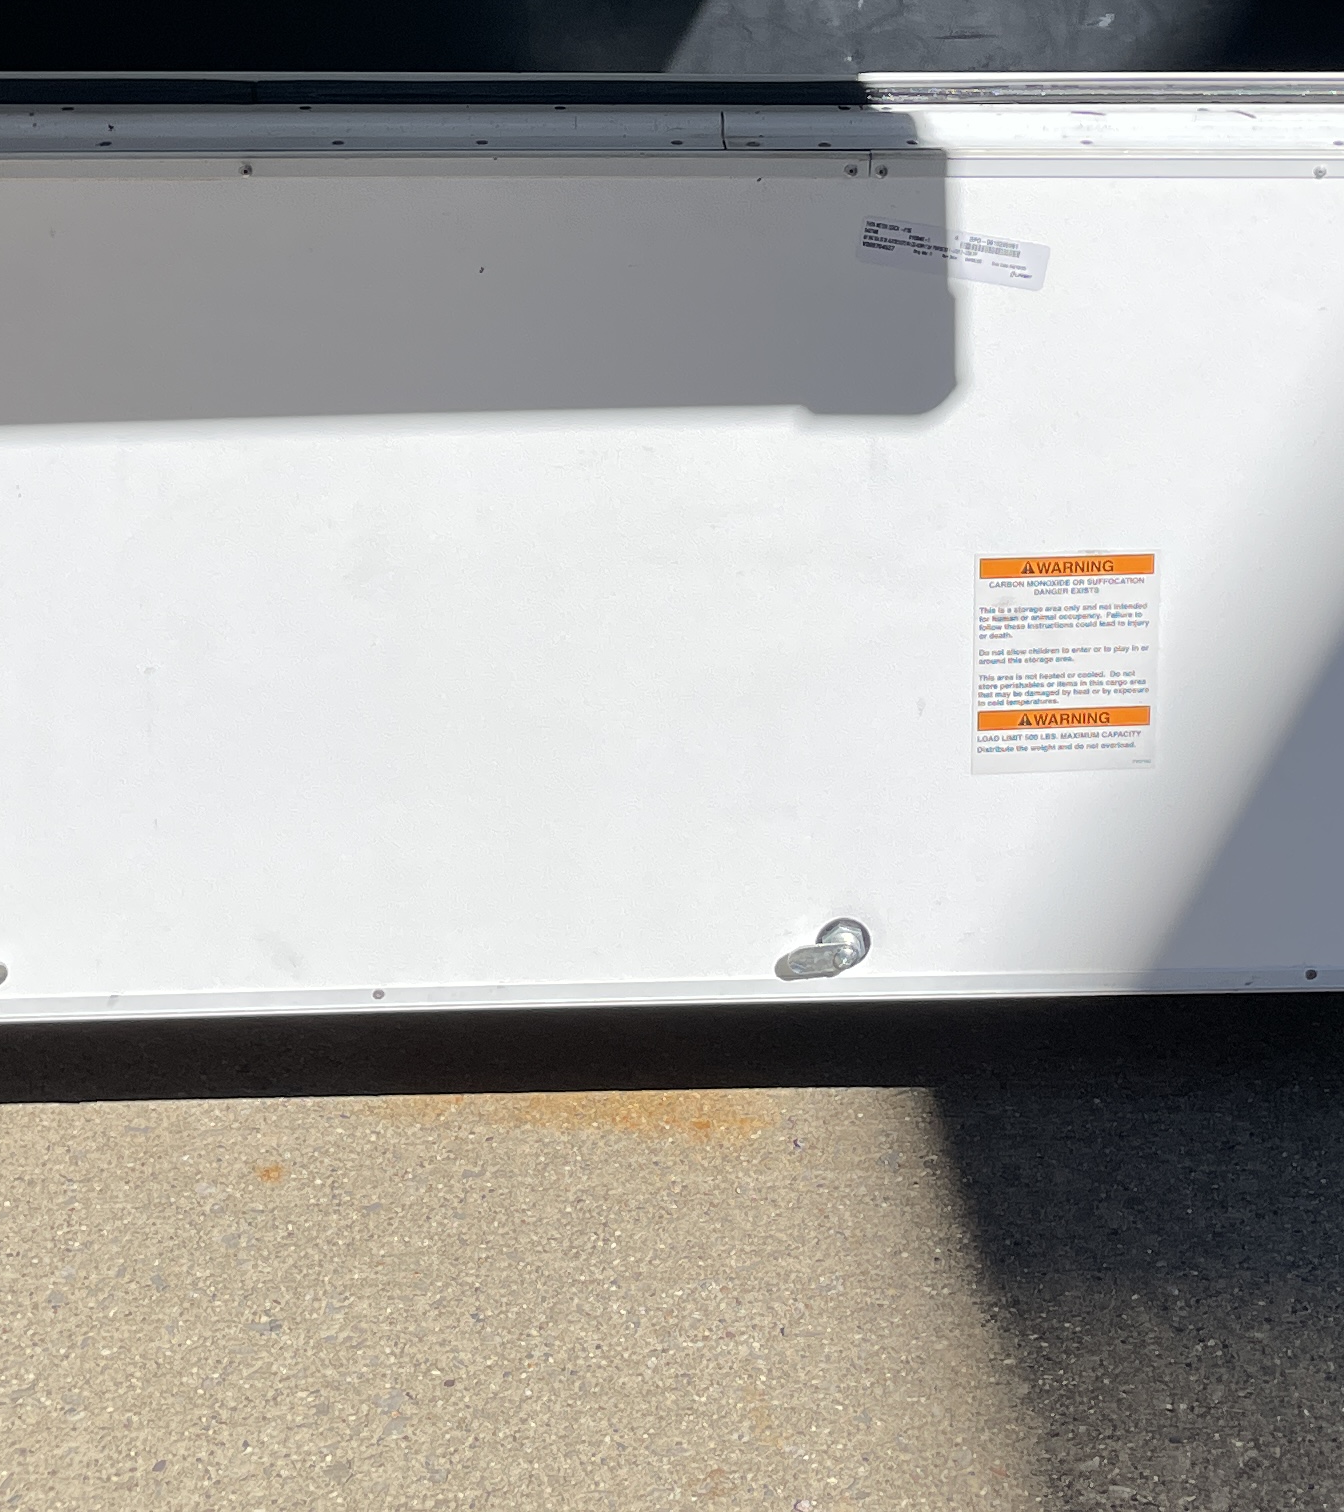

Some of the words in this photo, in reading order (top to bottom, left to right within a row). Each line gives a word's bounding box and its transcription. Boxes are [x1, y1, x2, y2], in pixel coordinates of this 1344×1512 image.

[1037, 560, 1114, 574] WARNING
[1087, 577, 1144, 585] SUFFOCATION
[1034, 712, 1110, 726] WARNING
